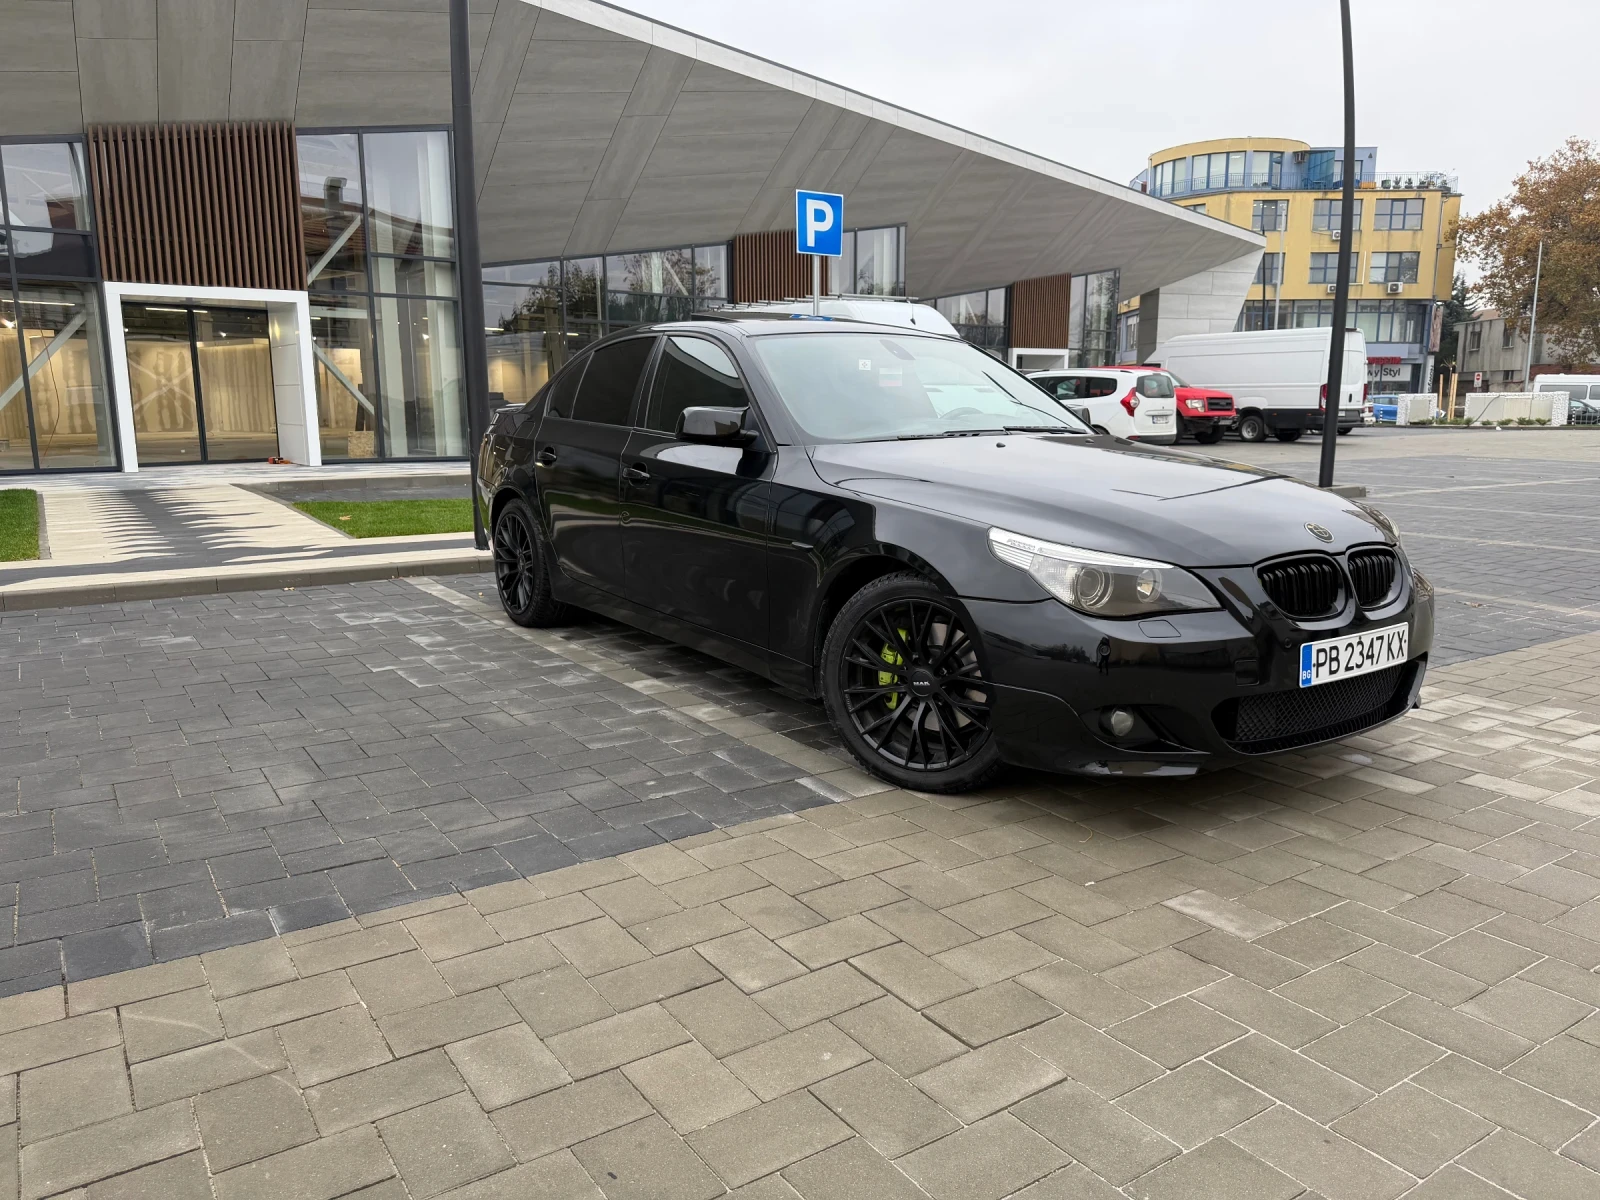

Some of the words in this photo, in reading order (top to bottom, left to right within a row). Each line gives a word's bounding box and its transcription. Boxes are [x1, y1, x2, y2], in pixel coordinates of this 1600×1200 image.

[806, 198, 834, 247] P
[1383, 368, 1401, 377] Styl
[1315, 645, 1340, 678] PB
[1344, 635, 1384, 672] 2347
[1387, 630, 1405, 661] KX
[1302, 670, 1311, 680] BG
